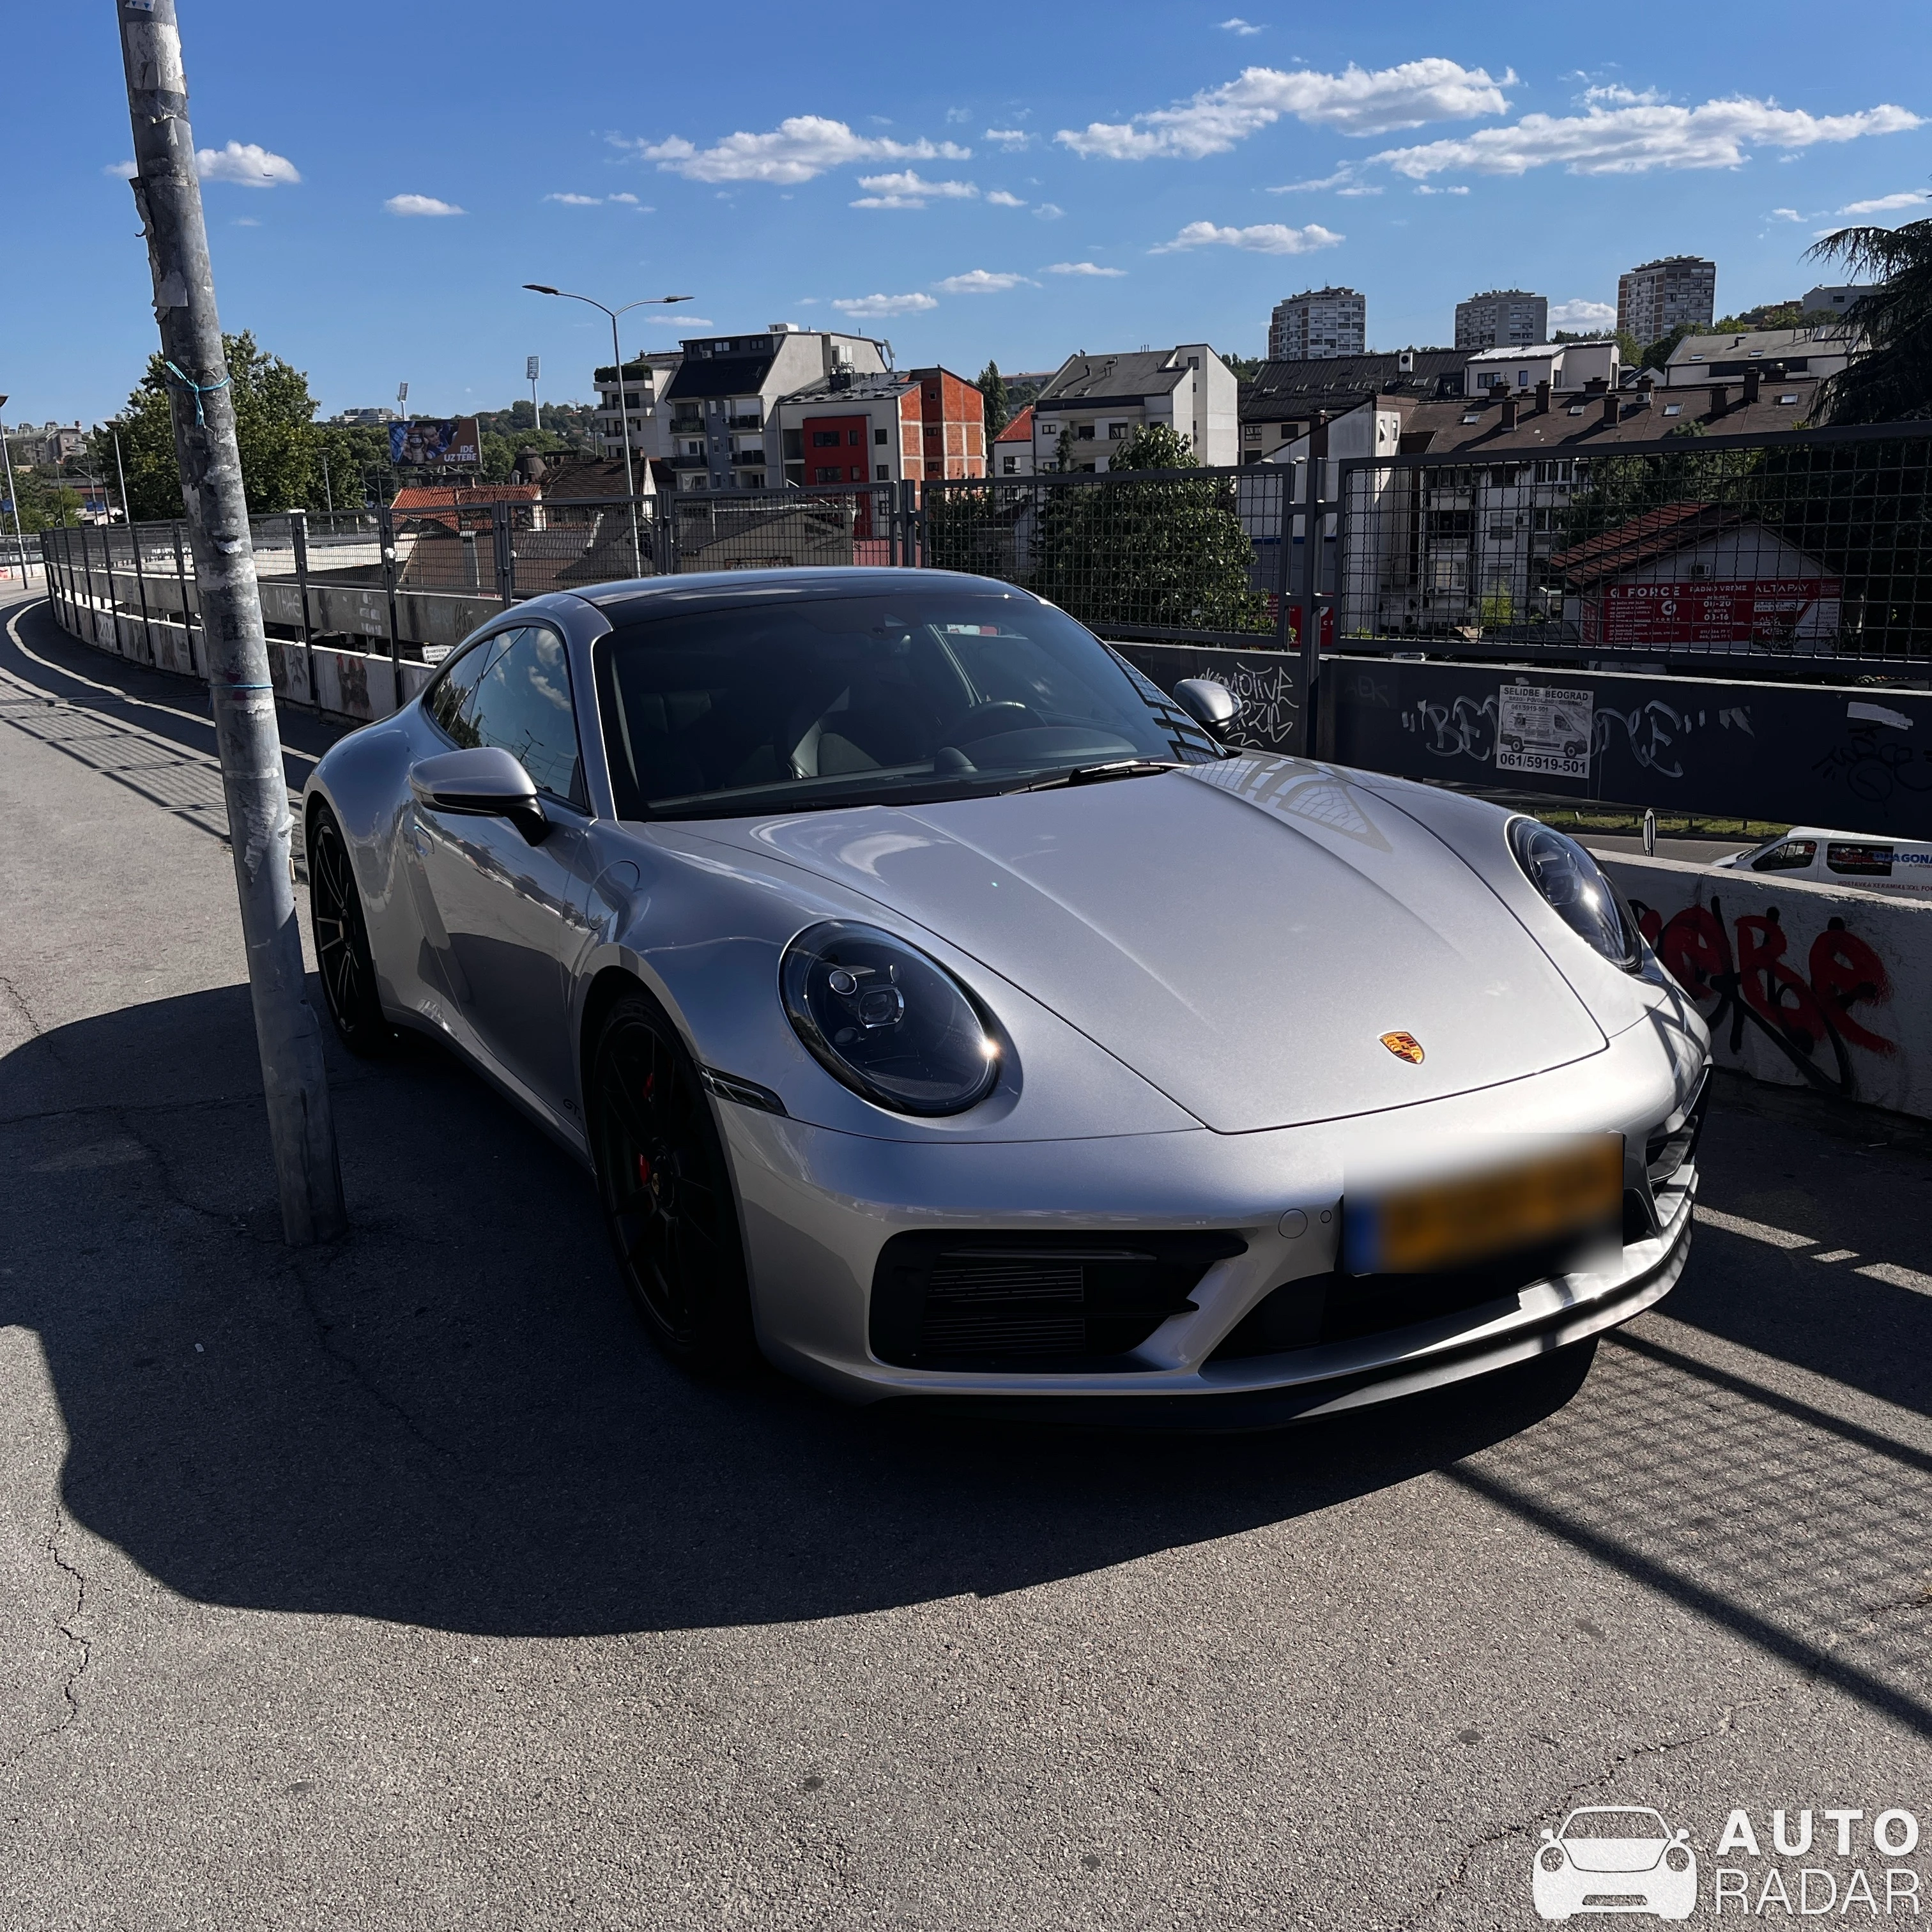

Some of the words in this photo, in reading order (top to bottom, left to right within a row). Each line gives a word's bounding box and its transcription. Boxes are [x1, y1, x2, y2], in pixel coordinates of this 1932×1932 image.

[444, 454, 456, 462] UZ
[1628, 586, 1680, 597] FORCE
[1504, 687, 1540, 697] SELIDBE
[1545, 690, 1588, 701] BEOGRAD
[1501, 753, 1586, 774] 061/5919-501
